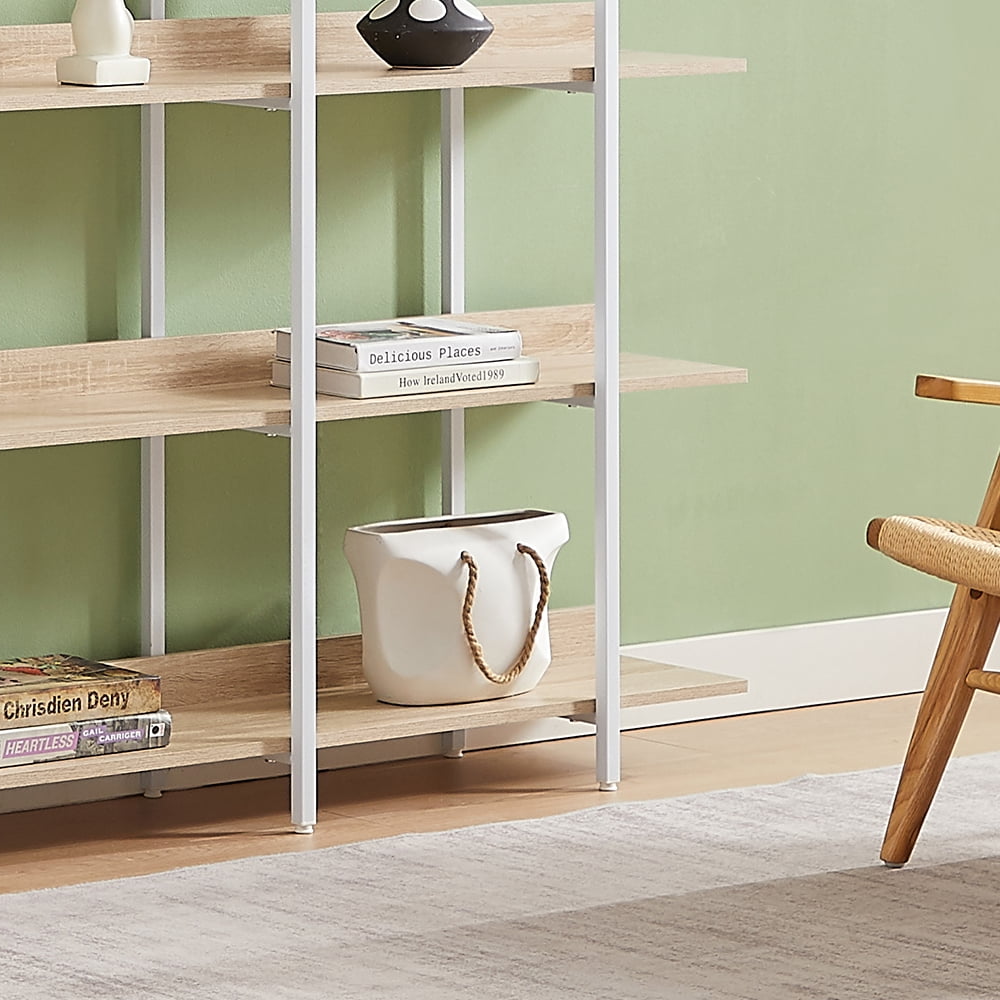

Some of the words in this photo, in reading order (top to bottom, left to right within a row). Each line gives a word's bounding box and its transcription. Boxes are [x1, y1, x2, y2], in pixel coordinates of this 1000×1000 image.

[369, 348, 432, 365] Delicious
[439, 346, 481, 359] Places
[399, 377, 420, 388] How
[3, 694, 82, 720] Chrisdien
[87, 690, 130, 710] Deny
[82, 729, 105, 737] GAIL
[99, 731, 142, 743] CARRIGER
[5, 734, 76, 756] HEARTLESS
